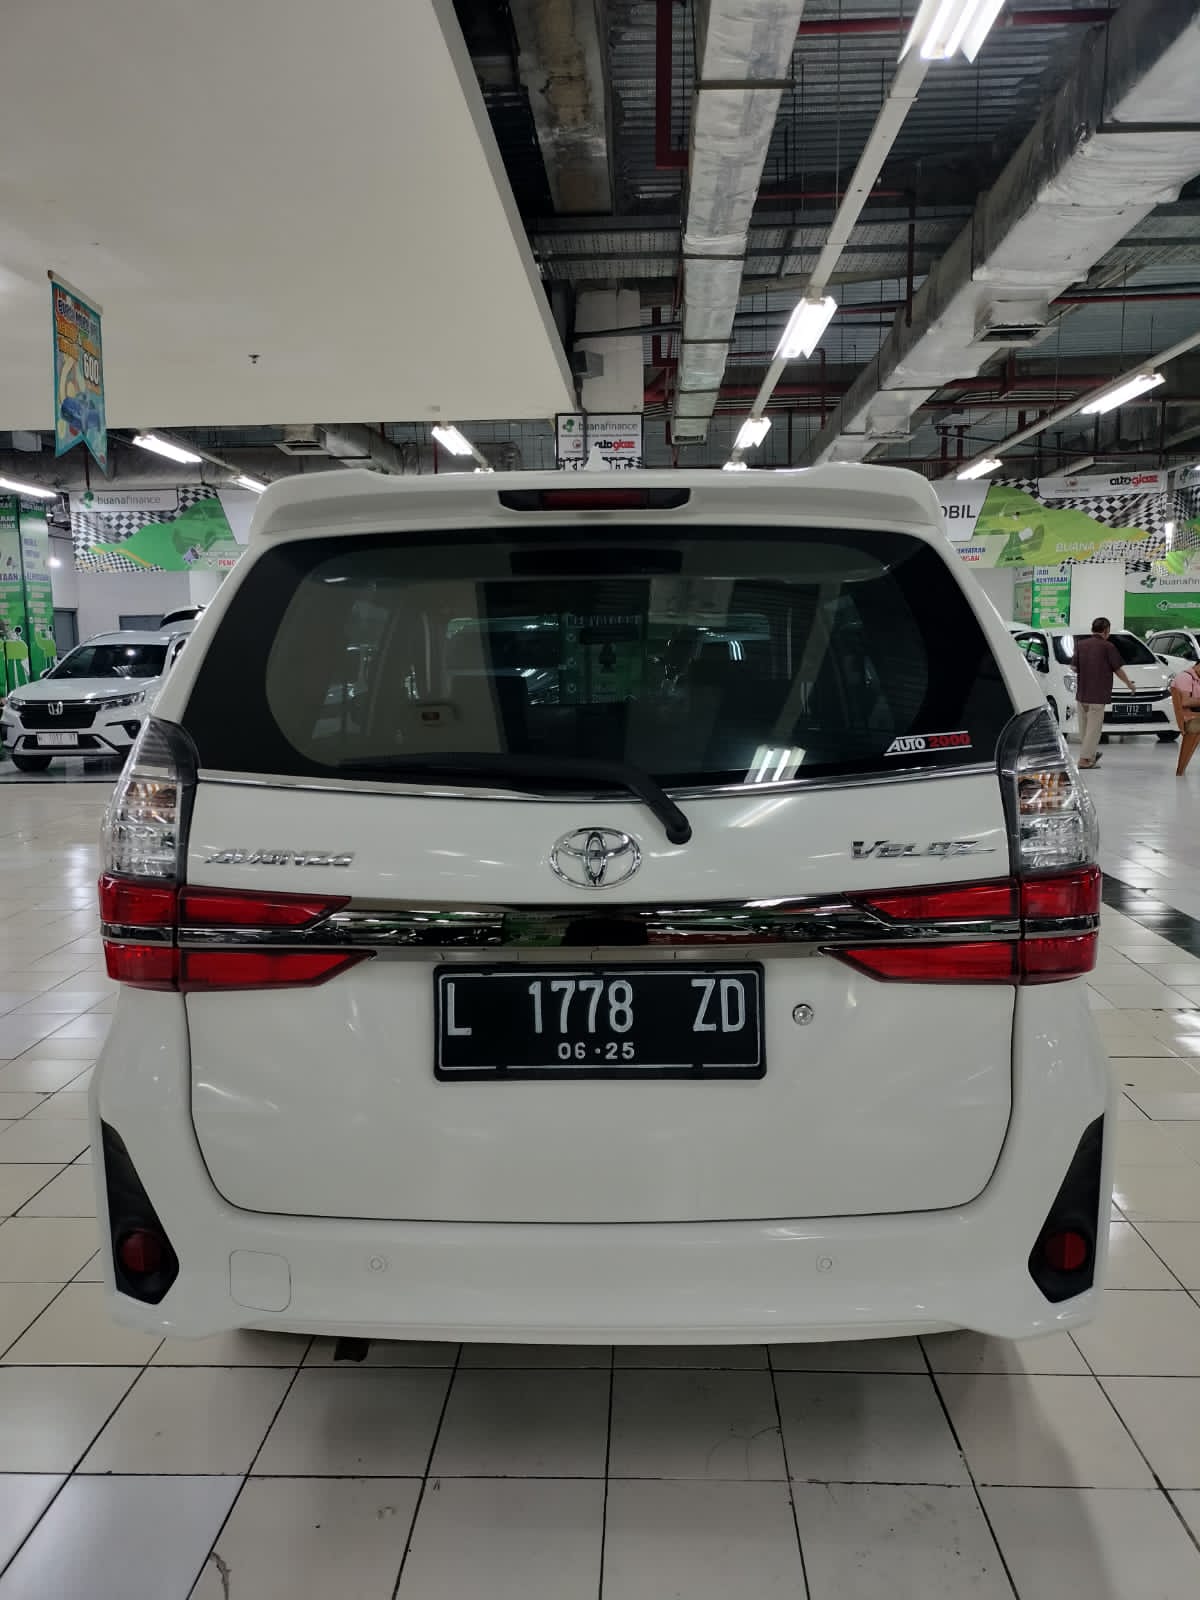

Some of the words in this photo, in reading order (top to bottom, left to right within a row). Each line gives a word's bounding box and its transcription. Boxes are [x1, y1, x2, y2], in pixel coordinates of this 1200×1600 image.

[97, 495, 161, 505] buanafinance
[886, 738, 926, 752] AUTO
[928, 734, 971, 748] 2000
[205, 848, 355, 867] AVANZA
[447, 982, 472, 1036] L
[528, 979, 634, 1034] 1778
[690, 977, 746, 1033] ZD
